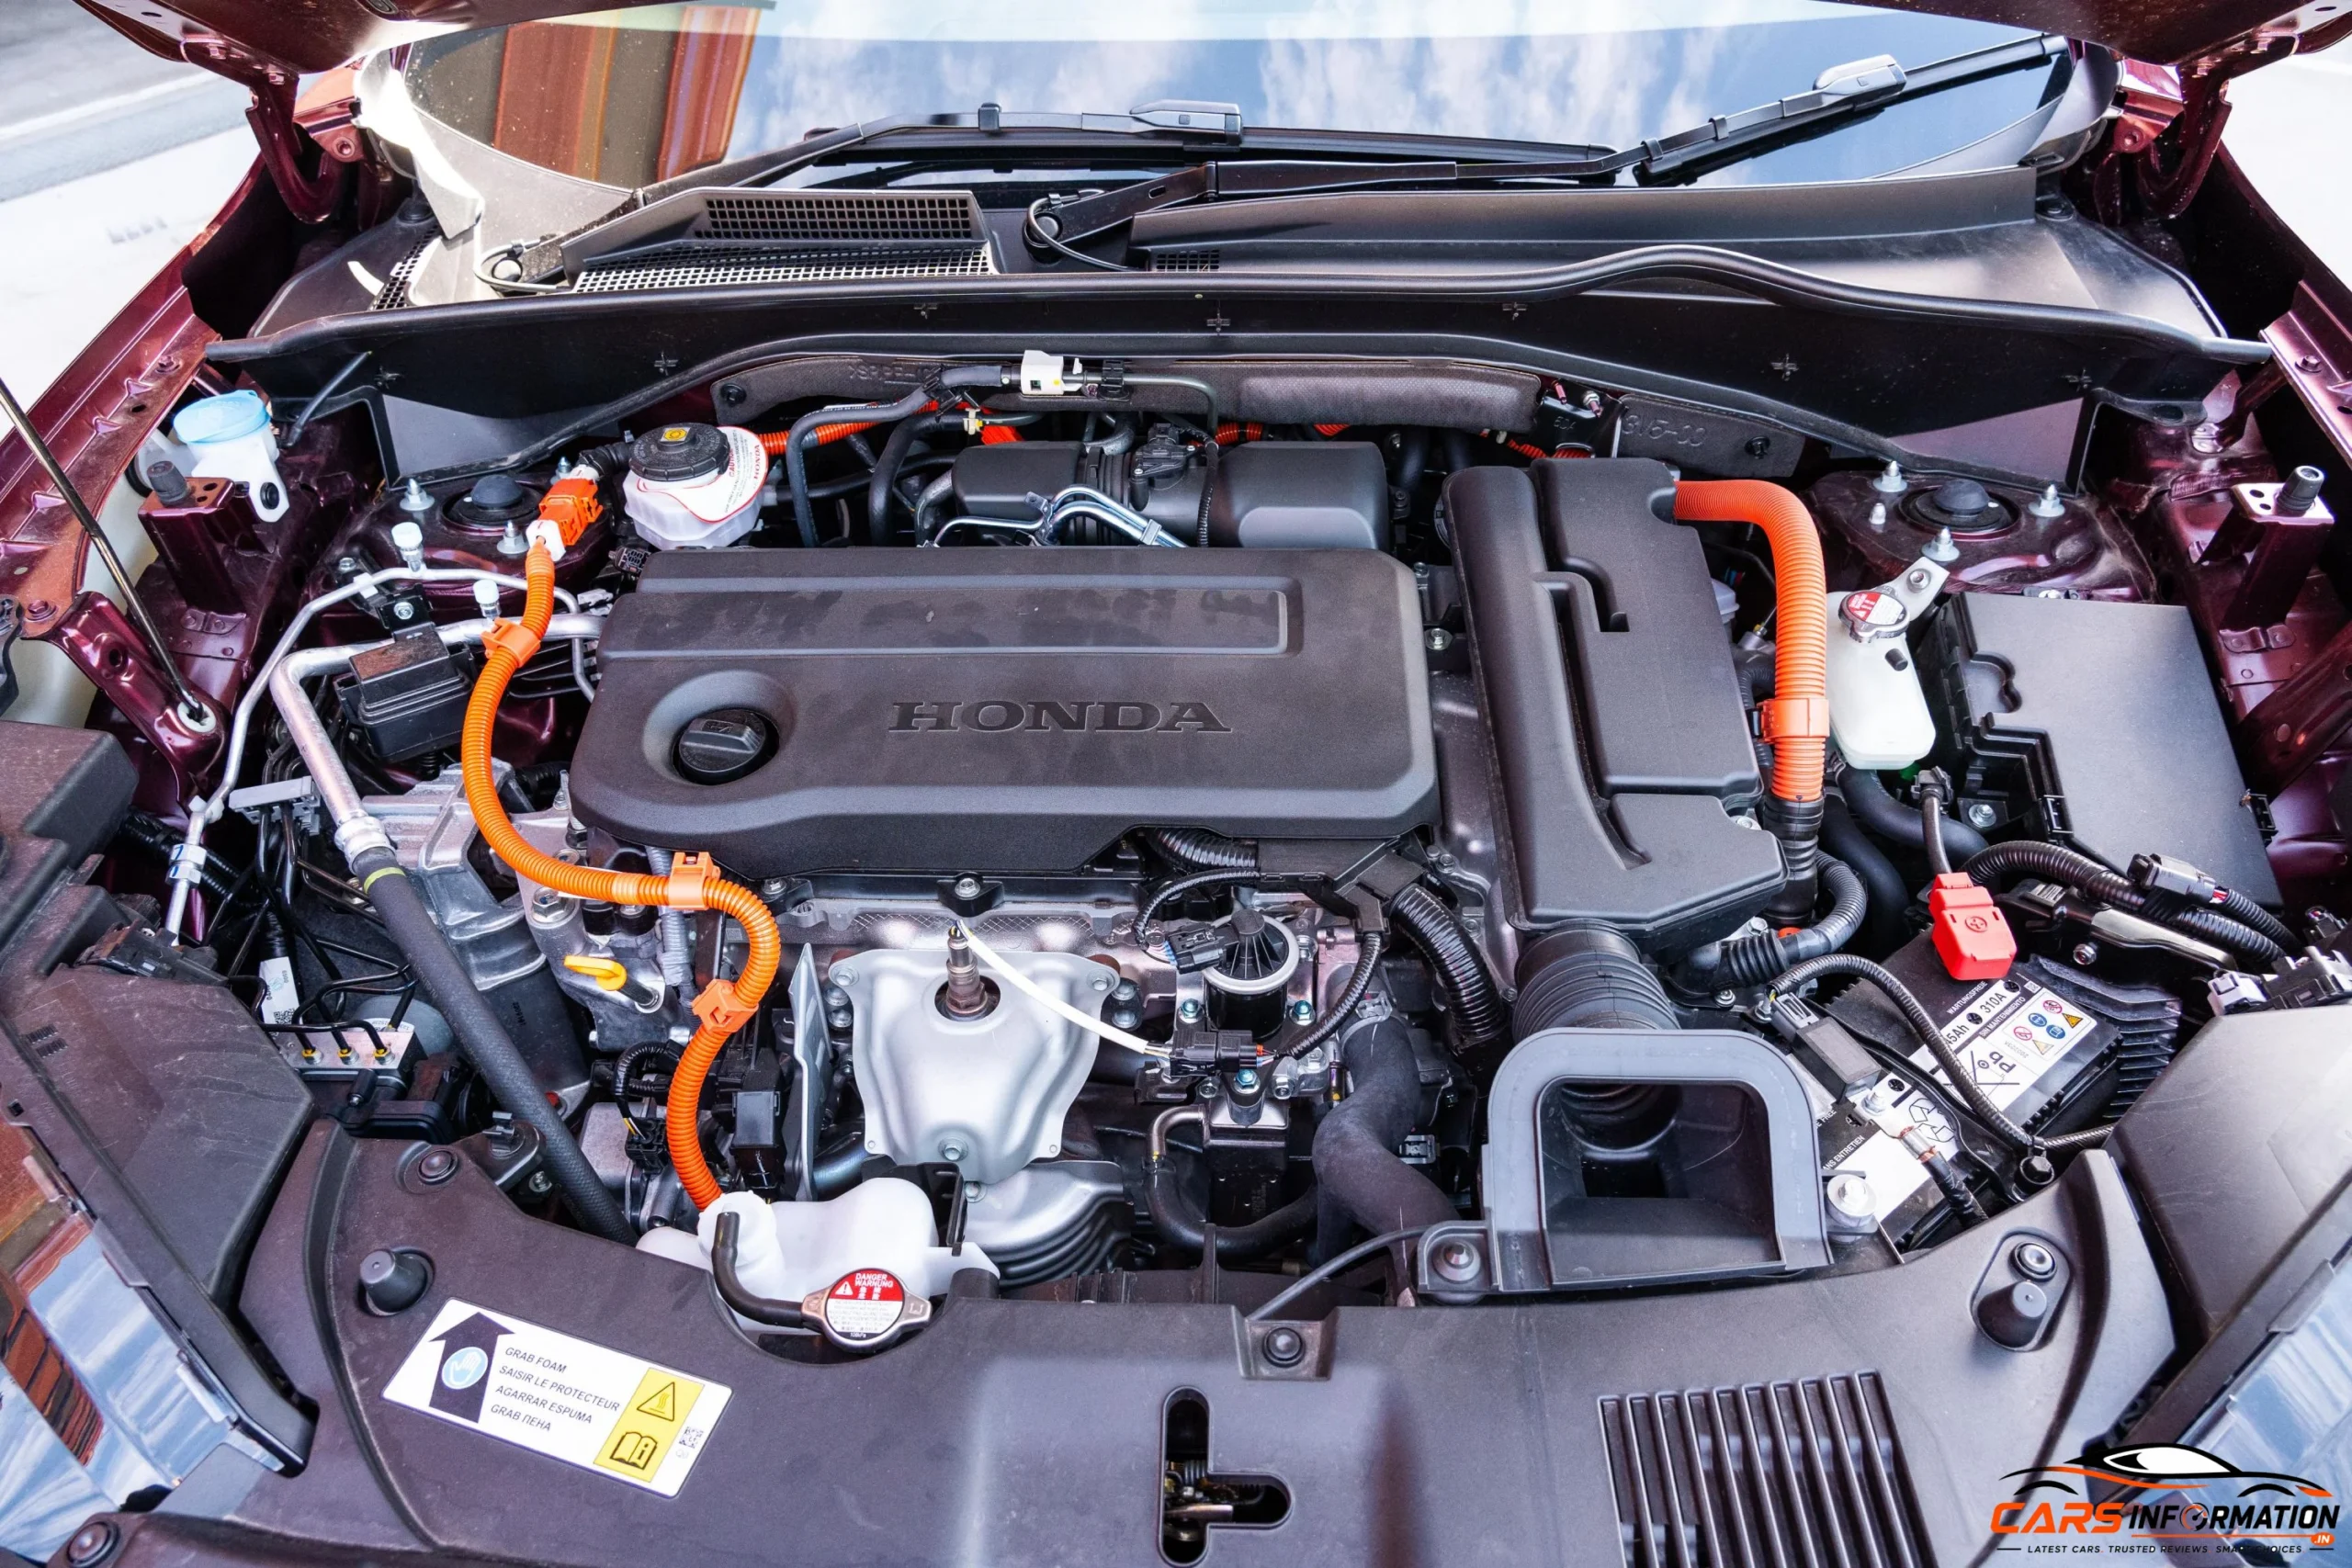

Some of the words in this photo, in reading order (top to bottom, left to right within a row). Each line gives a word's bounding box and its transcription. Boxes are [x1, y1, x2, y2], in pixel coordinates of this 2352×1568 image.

[888, 701, 1233, 733] HONDA
[1947, 980, 1989, 1015] WARTUNGSFREIE
[1979, 992, 2007, 1013] 310A
[1978, 1025, 1989, 1037] SIN
[1986, 996, 2026, 1032] MANTENIMIENTO
[1988, 1051, 2017, 1074] Pb
[1833, 1134, 1865, 1163] ENTRETIEN
[854, 1279, 894, 1288] WARNUNG
[505, 1347, 535, 1363] GRAB
[536, 1357, 567, 1374] FOAM
[499, 1365, 535, 1383] SAISIR
[534, 1376, 549, 1388] LE
[550, 1382, 620, 1412] PROTECTEUR
[491, 1404, 522, 1421] GRAB
[495, 1385, 548, 1409] AGARRAR
[548, 1402, 593, 1425] ESPUMA
